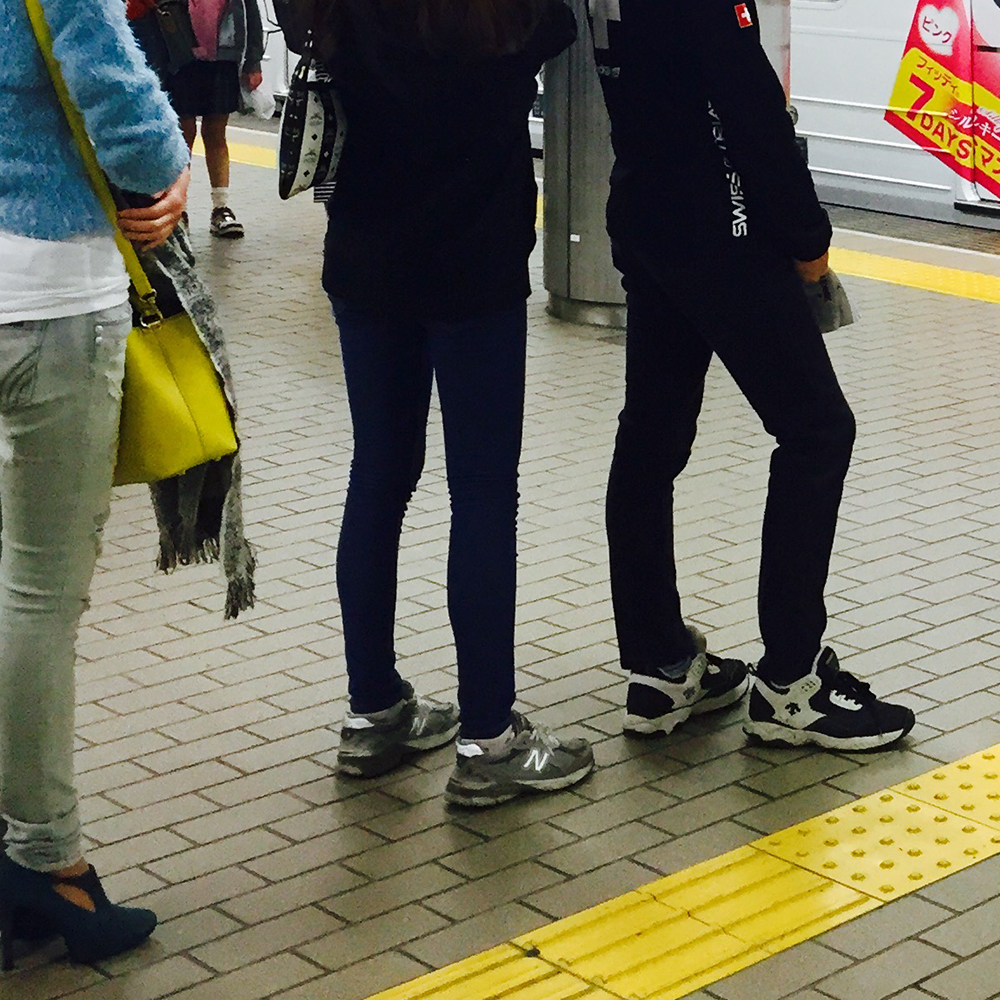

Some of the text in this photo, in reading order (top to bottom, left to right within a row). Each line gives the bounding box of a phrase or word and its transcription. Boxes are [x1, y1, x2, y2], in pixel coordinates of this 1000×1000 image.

[922, 15, 952, 43] ピンク
[917, 55, 957, 94] フィッティ
[523, 749, 550, 772] N
